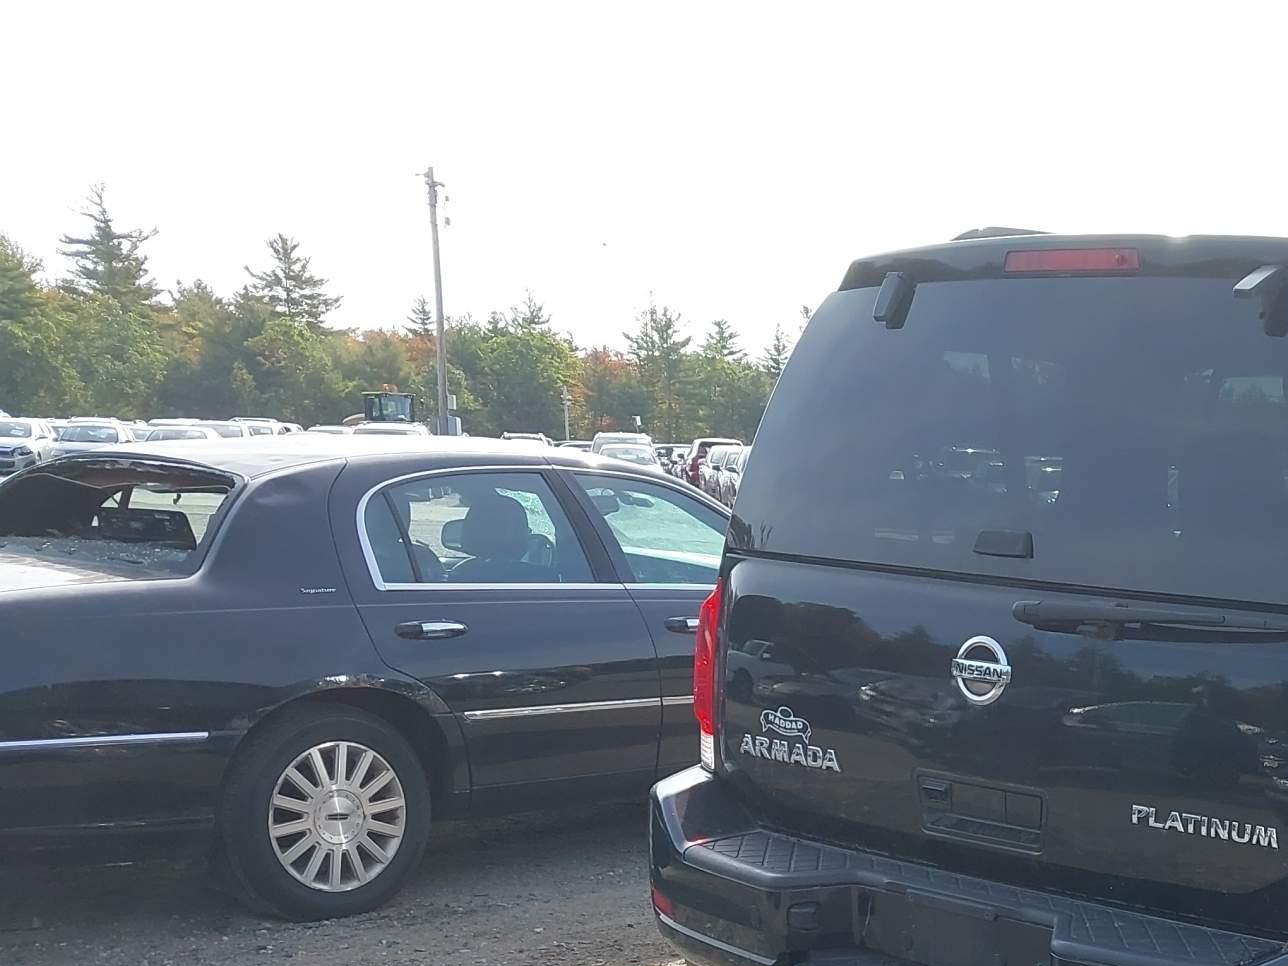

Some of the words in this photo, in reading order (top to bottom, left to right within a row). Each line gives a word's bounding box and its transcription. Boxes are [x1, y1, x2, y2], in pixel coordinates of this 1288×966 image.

[955, 661, 1003, 679] NISSAN
[768, 713, 804, 730] HADDAD
[740, 733, 841, 772] ARMADA
[1131, 804, 1279, 849] PLATINUM
